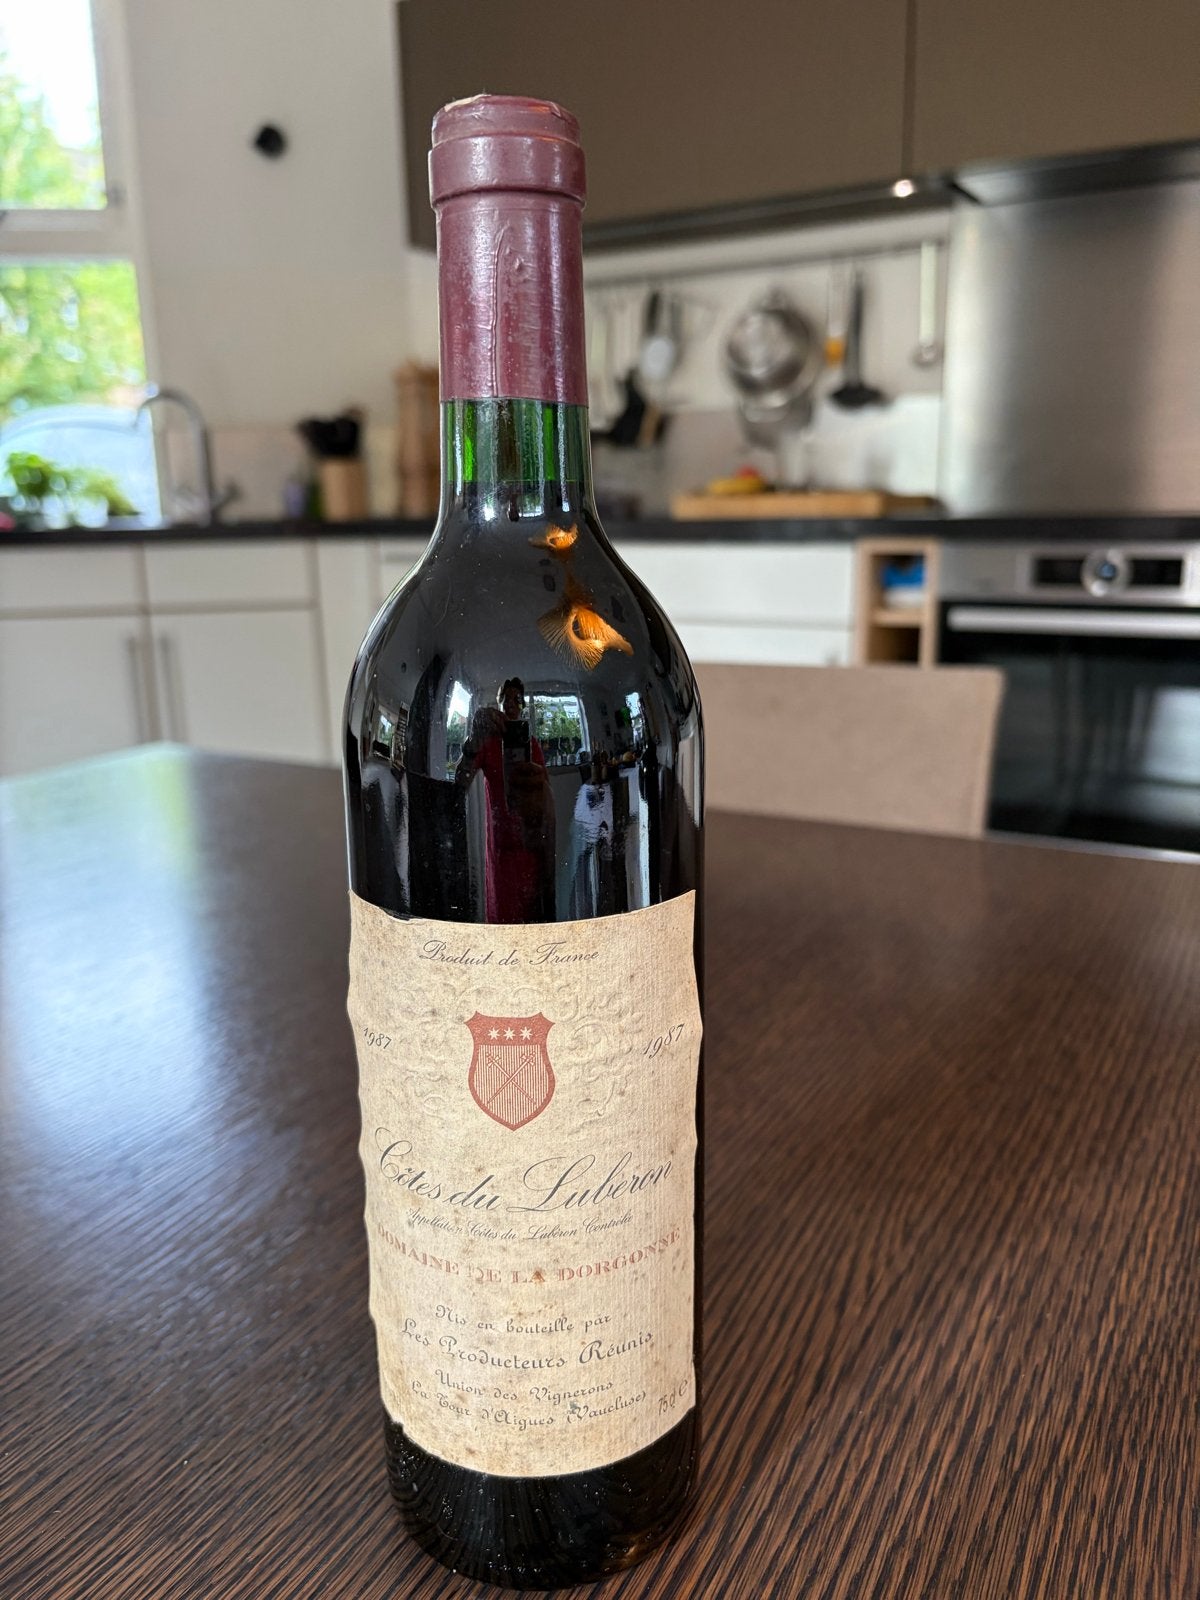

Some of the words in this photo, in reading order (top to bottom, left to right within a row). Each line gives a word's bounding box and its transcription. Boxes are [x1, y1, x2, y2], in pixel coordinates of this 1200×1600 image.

[418, 939, 492, 965] Produit
[498, 950, 519, 966] de
[529, 941, 600, 966] France
[363, 1027, 393, 1050] 1987
[643, 1023, 685, 1059] 1987
[375, 1127, 441, 1200] Côtes
[442, 1174, 501, 1211] du
[500, 1228, 518, 1240] du
[377, 1223, 460, 1276] DOMAINE
[467, 1262, 501, 1284] DE
[511, 1269, 546, 1284] LA
[557, 1227, 680, 1282] DORGONNE
[477, 1321, 495, 1331] en
[506, 1316, 575, 1334] bouteille
[584, 1314, 612, 1333] par
[401, 1317, 430, 1346] Les
[439, 1335, 567, 1370] Producteurs
[579, 1331, 653, 1364] Réunis
[435, 1368, 484, 1395] Union
[493, 1387, 518, 1401] des
[529, 1381, 614, 1406] Vignerons
